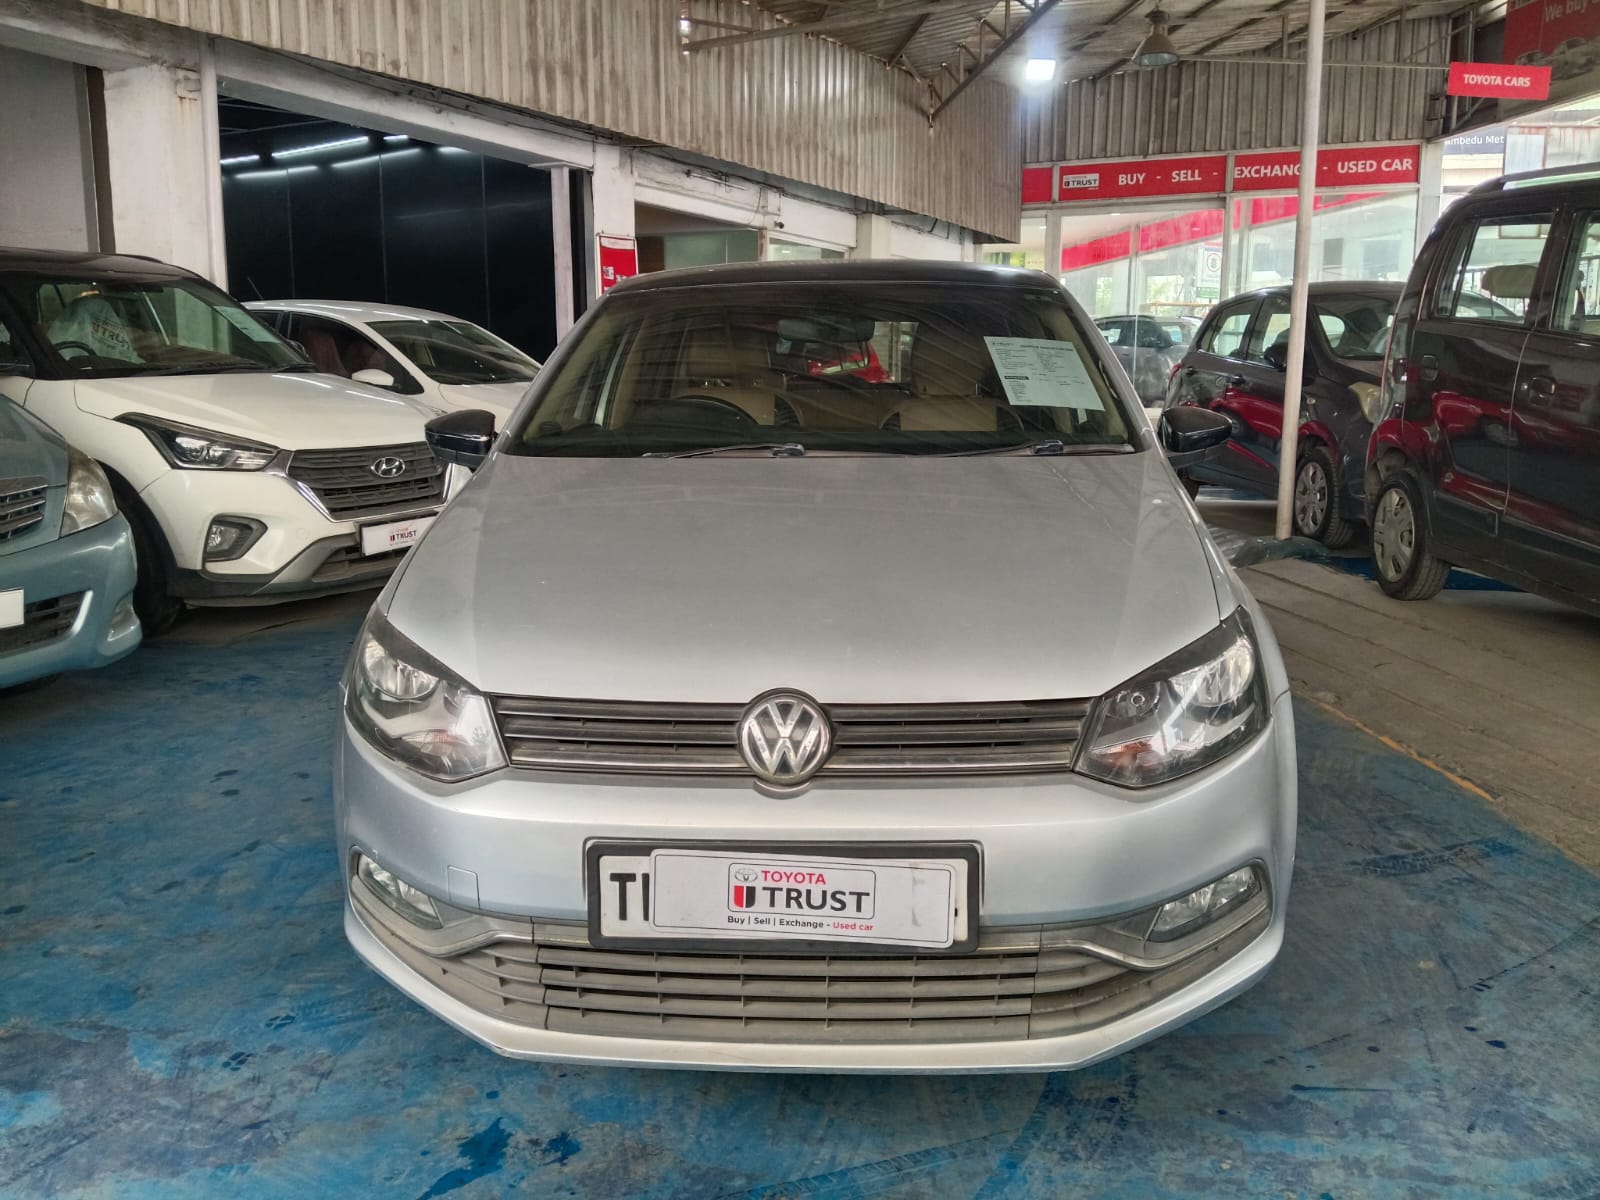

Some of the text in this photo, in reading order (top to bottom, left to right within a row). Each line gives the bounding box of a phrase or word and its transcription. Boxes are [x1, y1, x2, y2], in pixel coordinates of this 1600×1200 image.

[1464, 74, 1531, 88] TOYOTA CARS
[1118, 173, 1145, 186] BUY
[1171, 169, 1202, 183] SELL
[1337, 160, 1377, 174] USED
[1381, 158, 1413, 171] CAR
[761, 870, 826, 885] TOYOTA
[762, 886, 870, 913] TRUST
[727, 915, 745, 925] Buy
[754, 917, 770, 925] Sell
[779, 918, 824, 929] Exchange
[832, 922, 857, 930] Used
